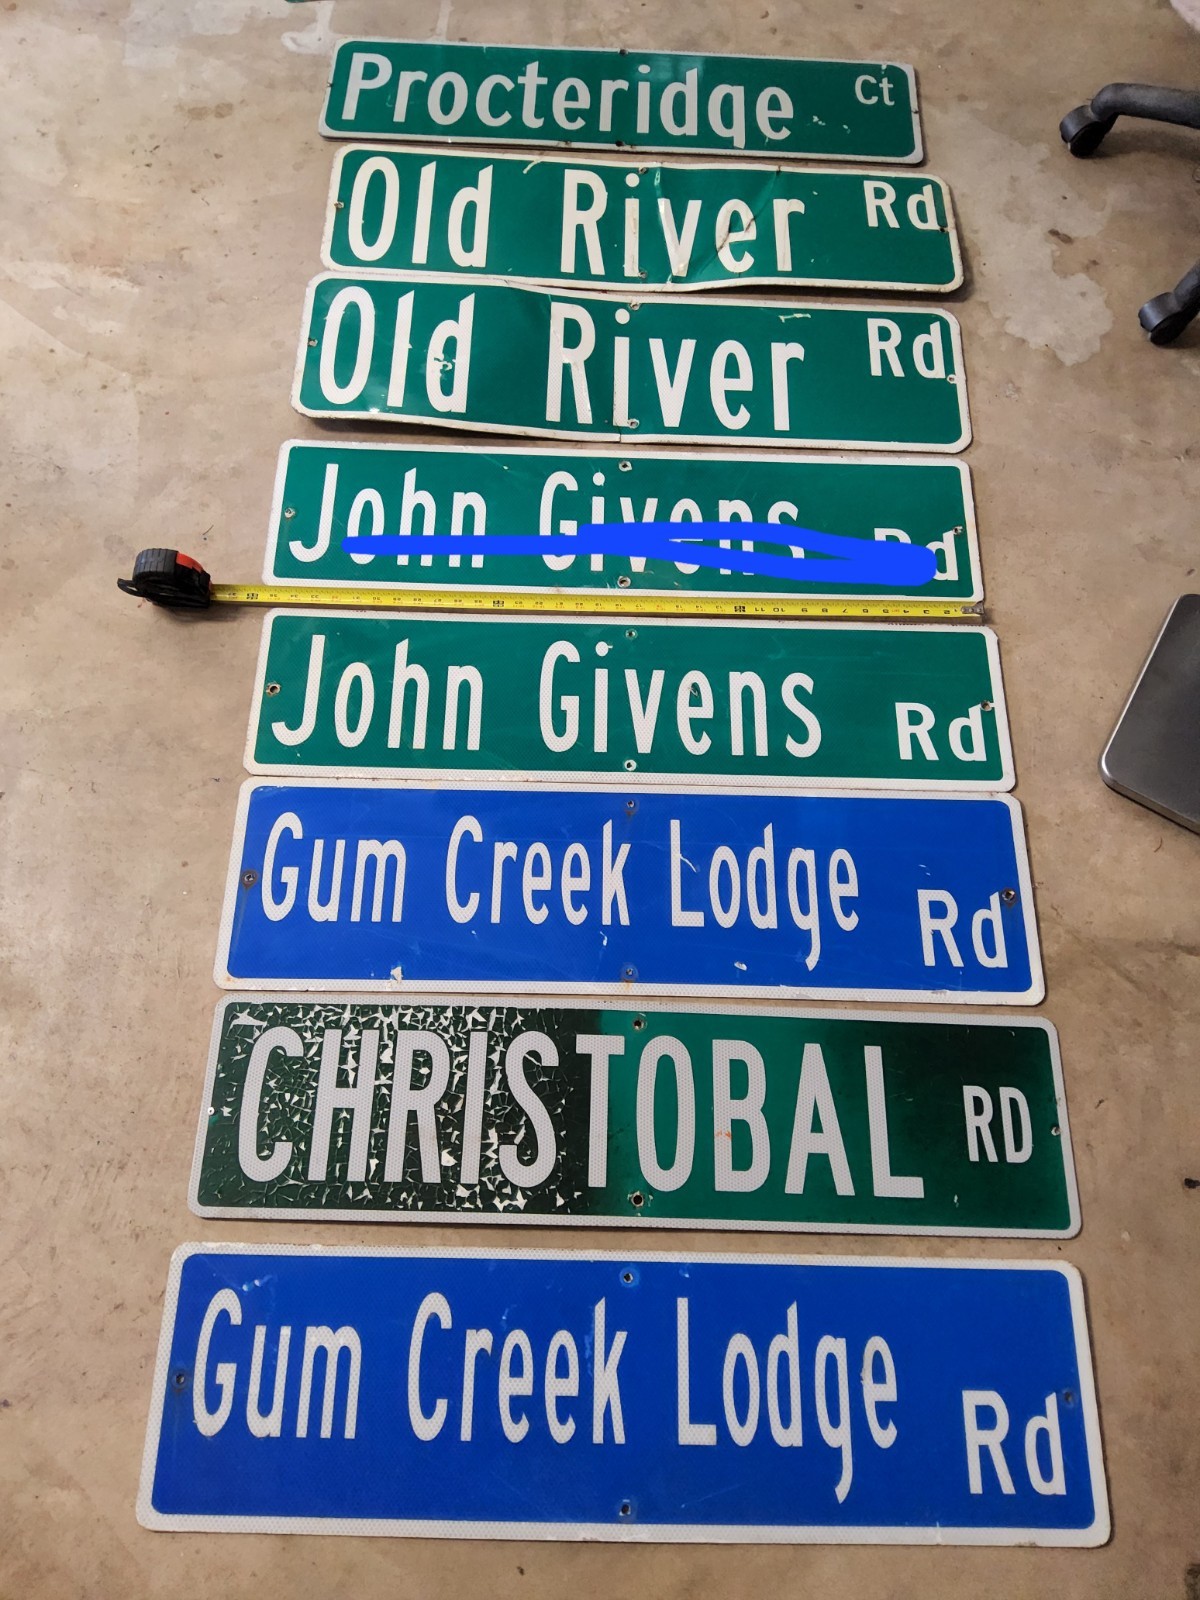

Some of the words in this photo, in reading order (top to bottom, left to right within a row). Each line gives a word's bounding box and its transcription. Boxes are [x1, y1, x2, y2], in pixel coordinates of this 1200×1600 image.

[855, 75, 895, 106] Ct
[346, 156, 494, 268] Old
[561, 167, 805, 278] River
[864, 179, 940, 231] Rd
[318, 285, 476, 414] Old
[545, 301, 805, 432] River
[867, 317, 944, 379] Rd
[288, 463, 487, 569] John
[270, 634, 484, 751] John
[538, 639, 822, 758] Givens
[895, 702, 988, 763] Rd
[262, 812, 407, 923] Gum
[446, 816, 631, 926] Creek
[671, 820, 859, 971] Lodge
[918, 889, 1008, 968] Rd
[237, 1024, 925, 1198] CHRISTOBAL
[963, 1086, 1033, 1164] RD
[193, 1288, 362, 1439] Gum
[408, 1292, 627, 1444] Creek
[677, 1298, 898, 1503] Lodge
[963, 1390, 1067, 1496] Rd
